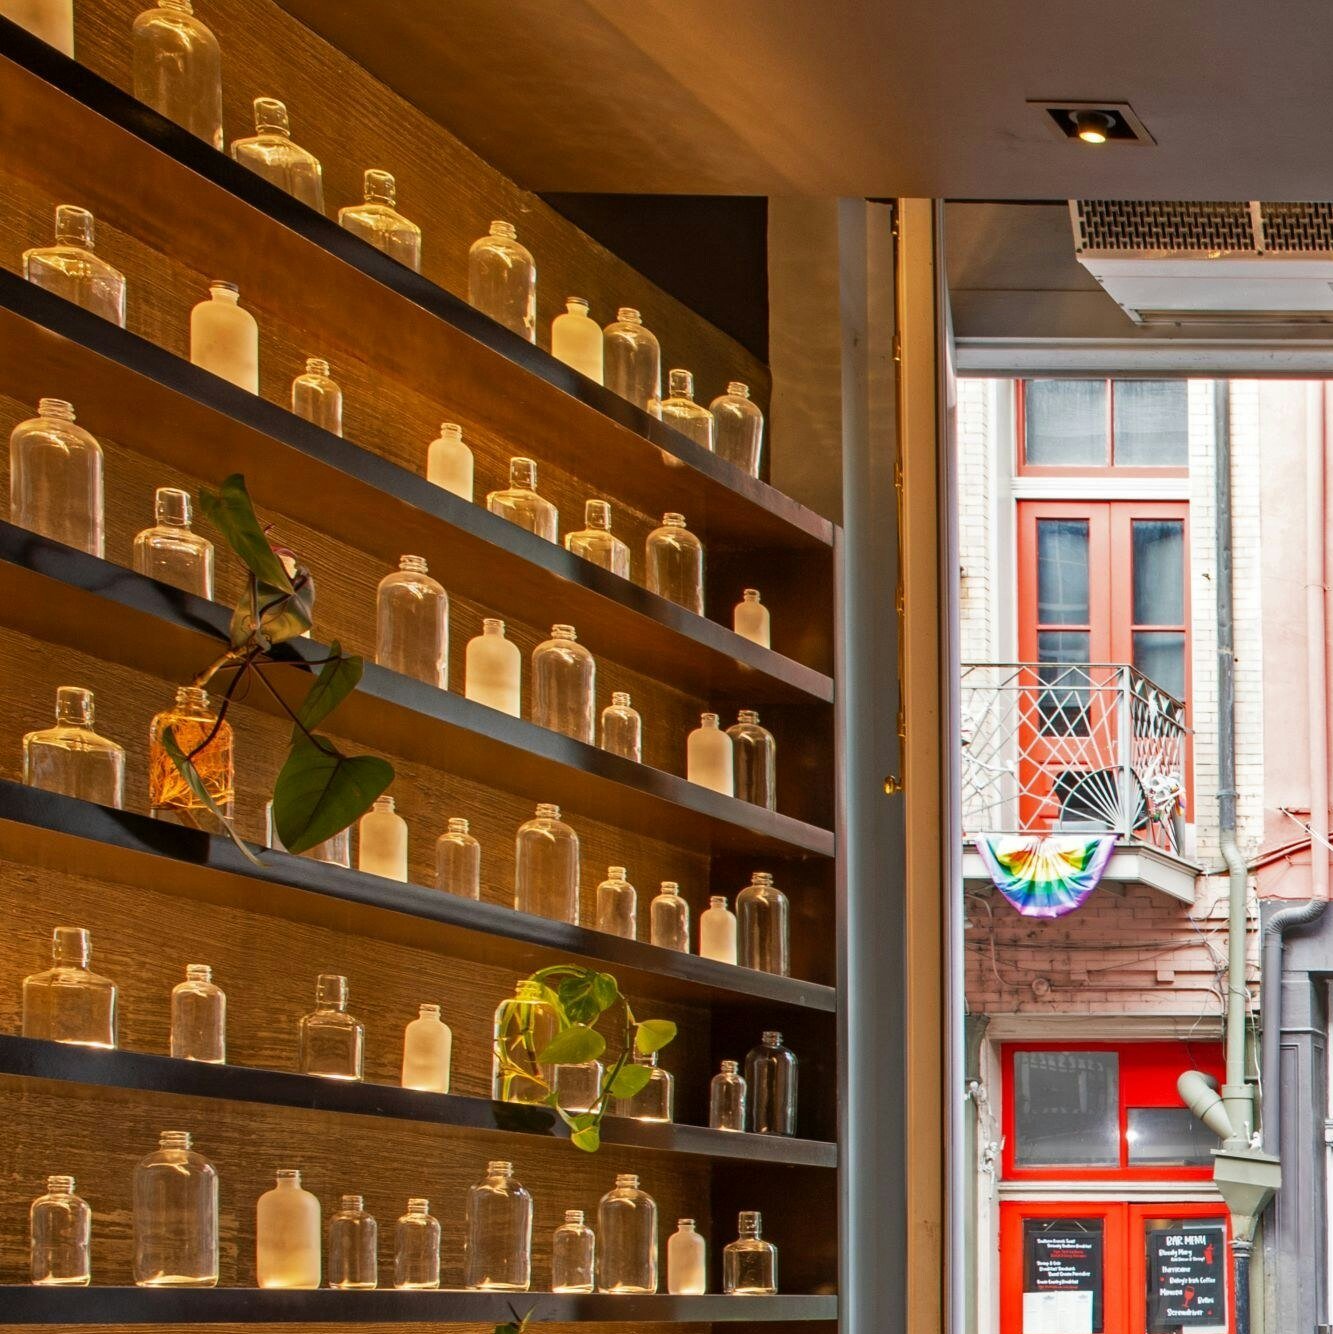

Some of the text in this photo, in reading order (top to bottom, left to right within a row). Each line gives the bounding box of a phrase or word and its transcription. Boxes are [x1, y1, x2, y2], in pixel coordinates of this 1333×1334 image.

[1166, 1235, 1206, 1247] BAR MENU
[1167, 1308, 1204, 1317] Screwdriver
